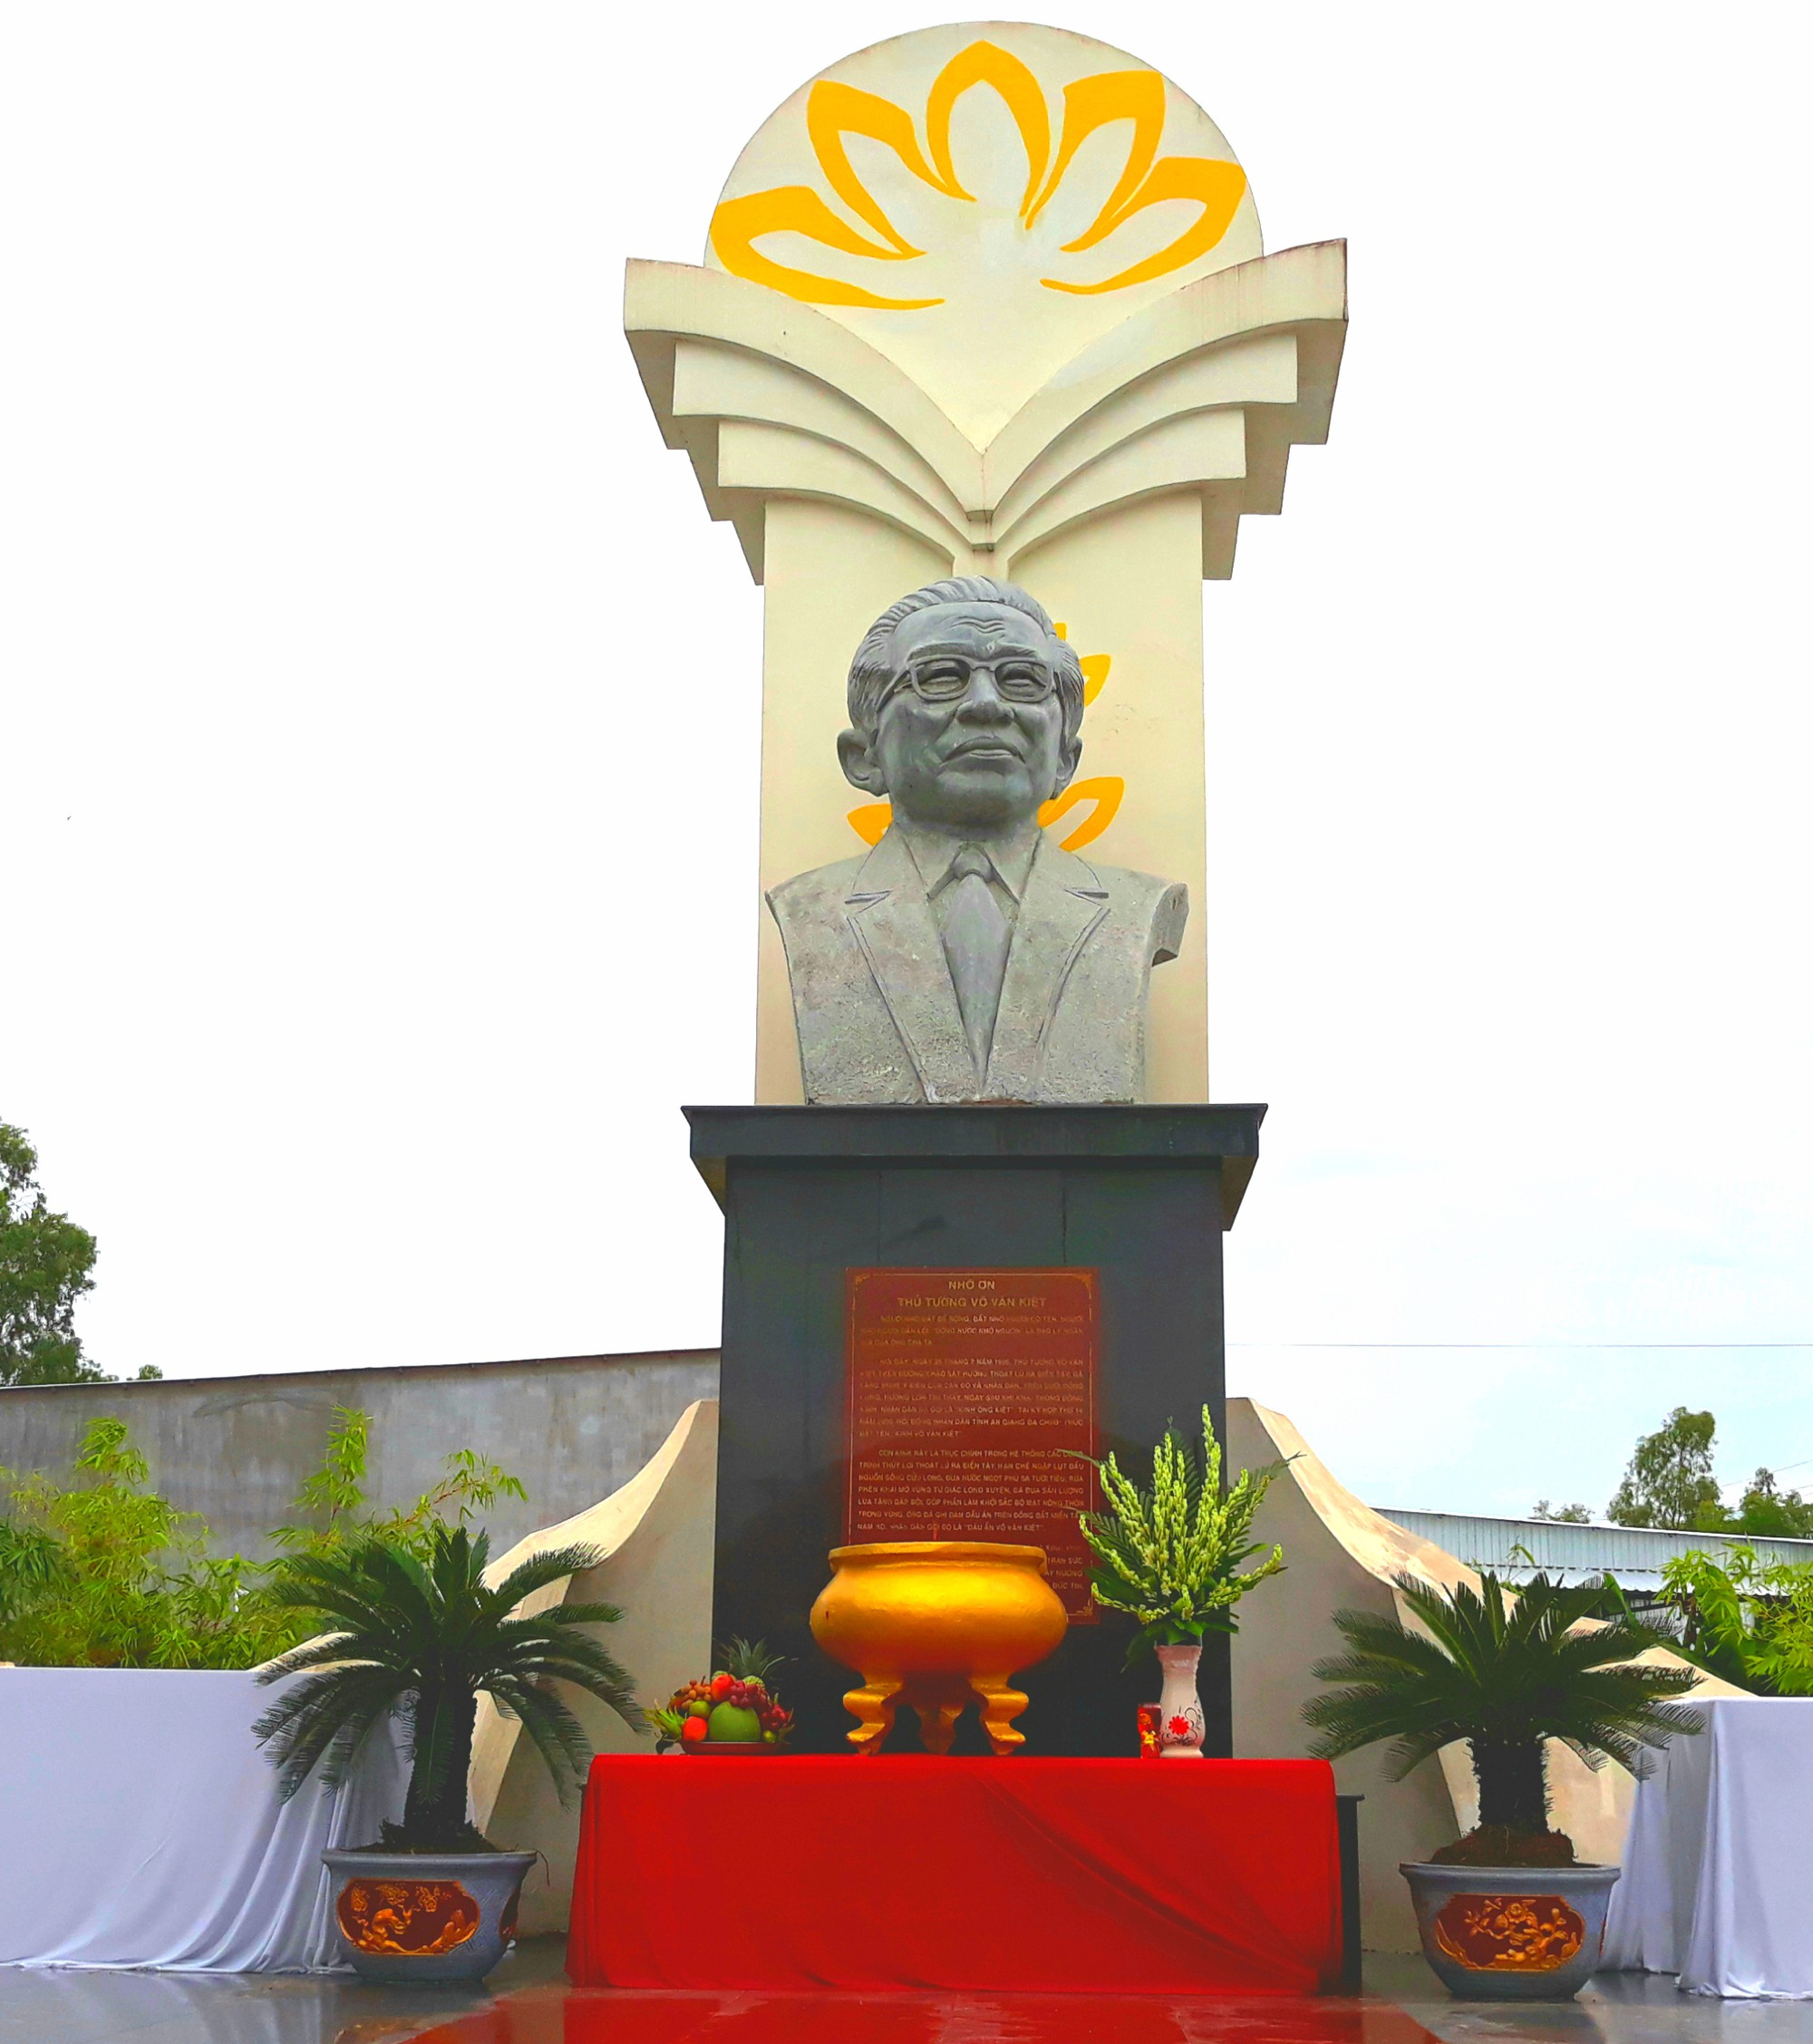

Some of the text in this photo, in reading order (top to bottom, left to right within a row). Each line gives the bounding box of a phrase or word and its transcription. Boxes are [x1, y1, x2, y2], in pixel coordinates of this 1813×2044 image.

[948, 1279, 995, 1290] NHỚ ƠN
[897, 1295, 1047, 1307] THỦ TƯỚNG VÕ VĂN KIỆT
